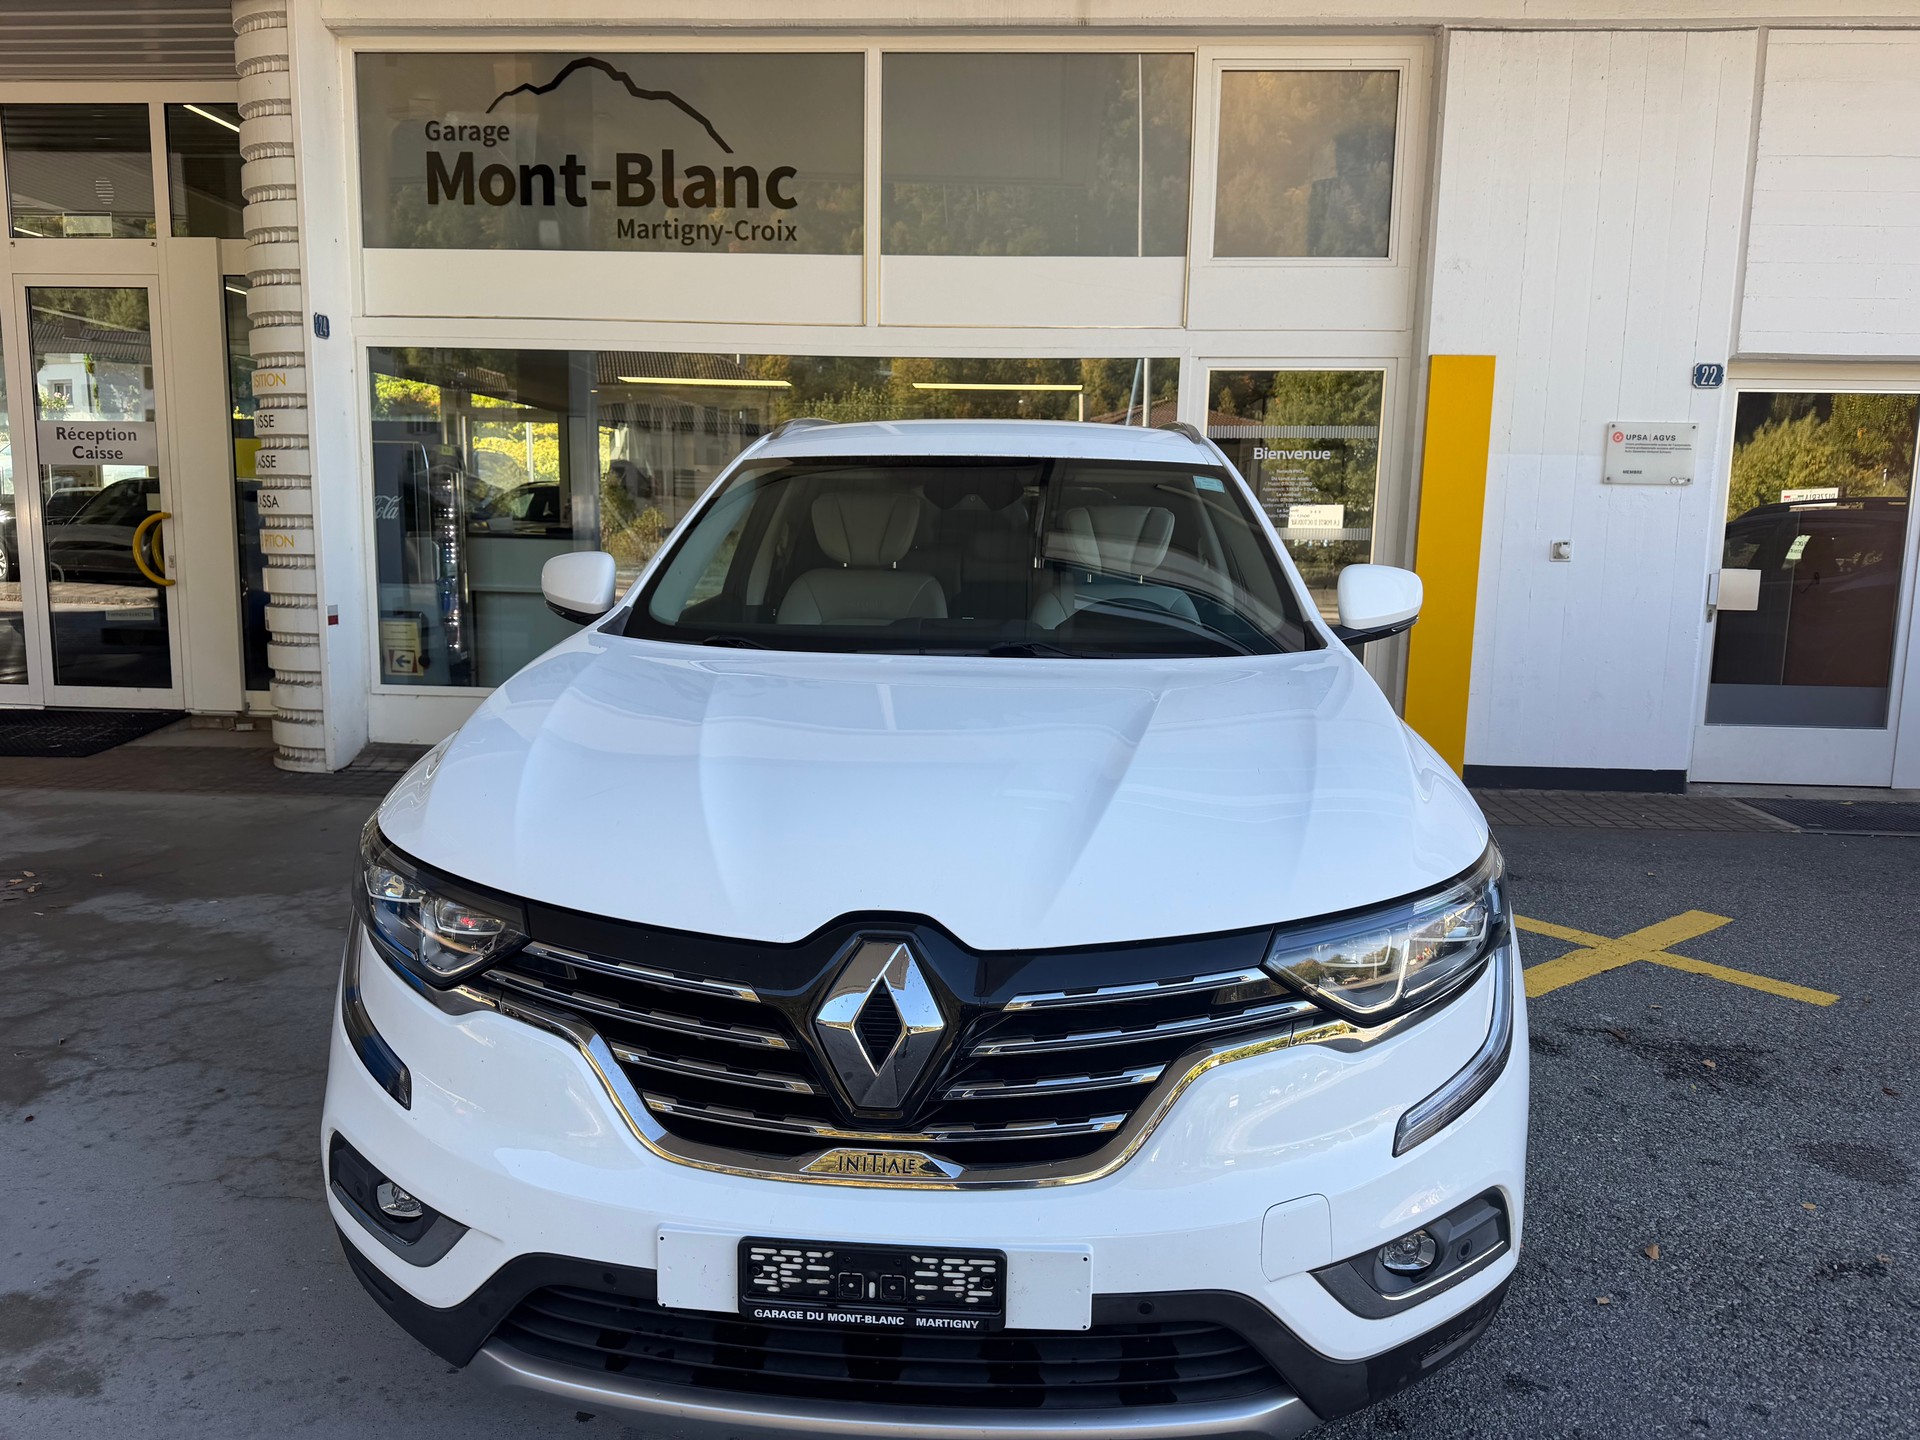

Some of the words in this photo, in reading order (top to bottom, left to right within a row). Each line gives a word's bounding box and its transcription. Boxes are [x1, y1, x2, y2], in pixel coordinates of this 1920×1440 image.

[424, 120, 511, 147] Garage
[425, 149, 799, 210] Mont-Blanc
[616, 217, 798, 246] Martigny-Croix
[319, 315, 328, 336] 24
[254, 373, 287, 388] SITION
[1701, 365, 1718, 385] 22
[56, 426, 137, 444] Réception
[1652, 434, 1676, 442] AGVS
[72, 446, 124, 460] Caisse
[256, 454, 277, 469] ASSE
[1253, 447, 1331, 460] Bienvenue
[262, 534, 295, 548] PTION
[839, 1153, 916, 1174] INITIALE
[754, 1309, 803, 1320] GARAGE
[806, 1311, 824, 1321] DU
[827, 1313, 905, 1326] MONT-BLANC
[916, 1317, 979, 1329] MARTIGNY
